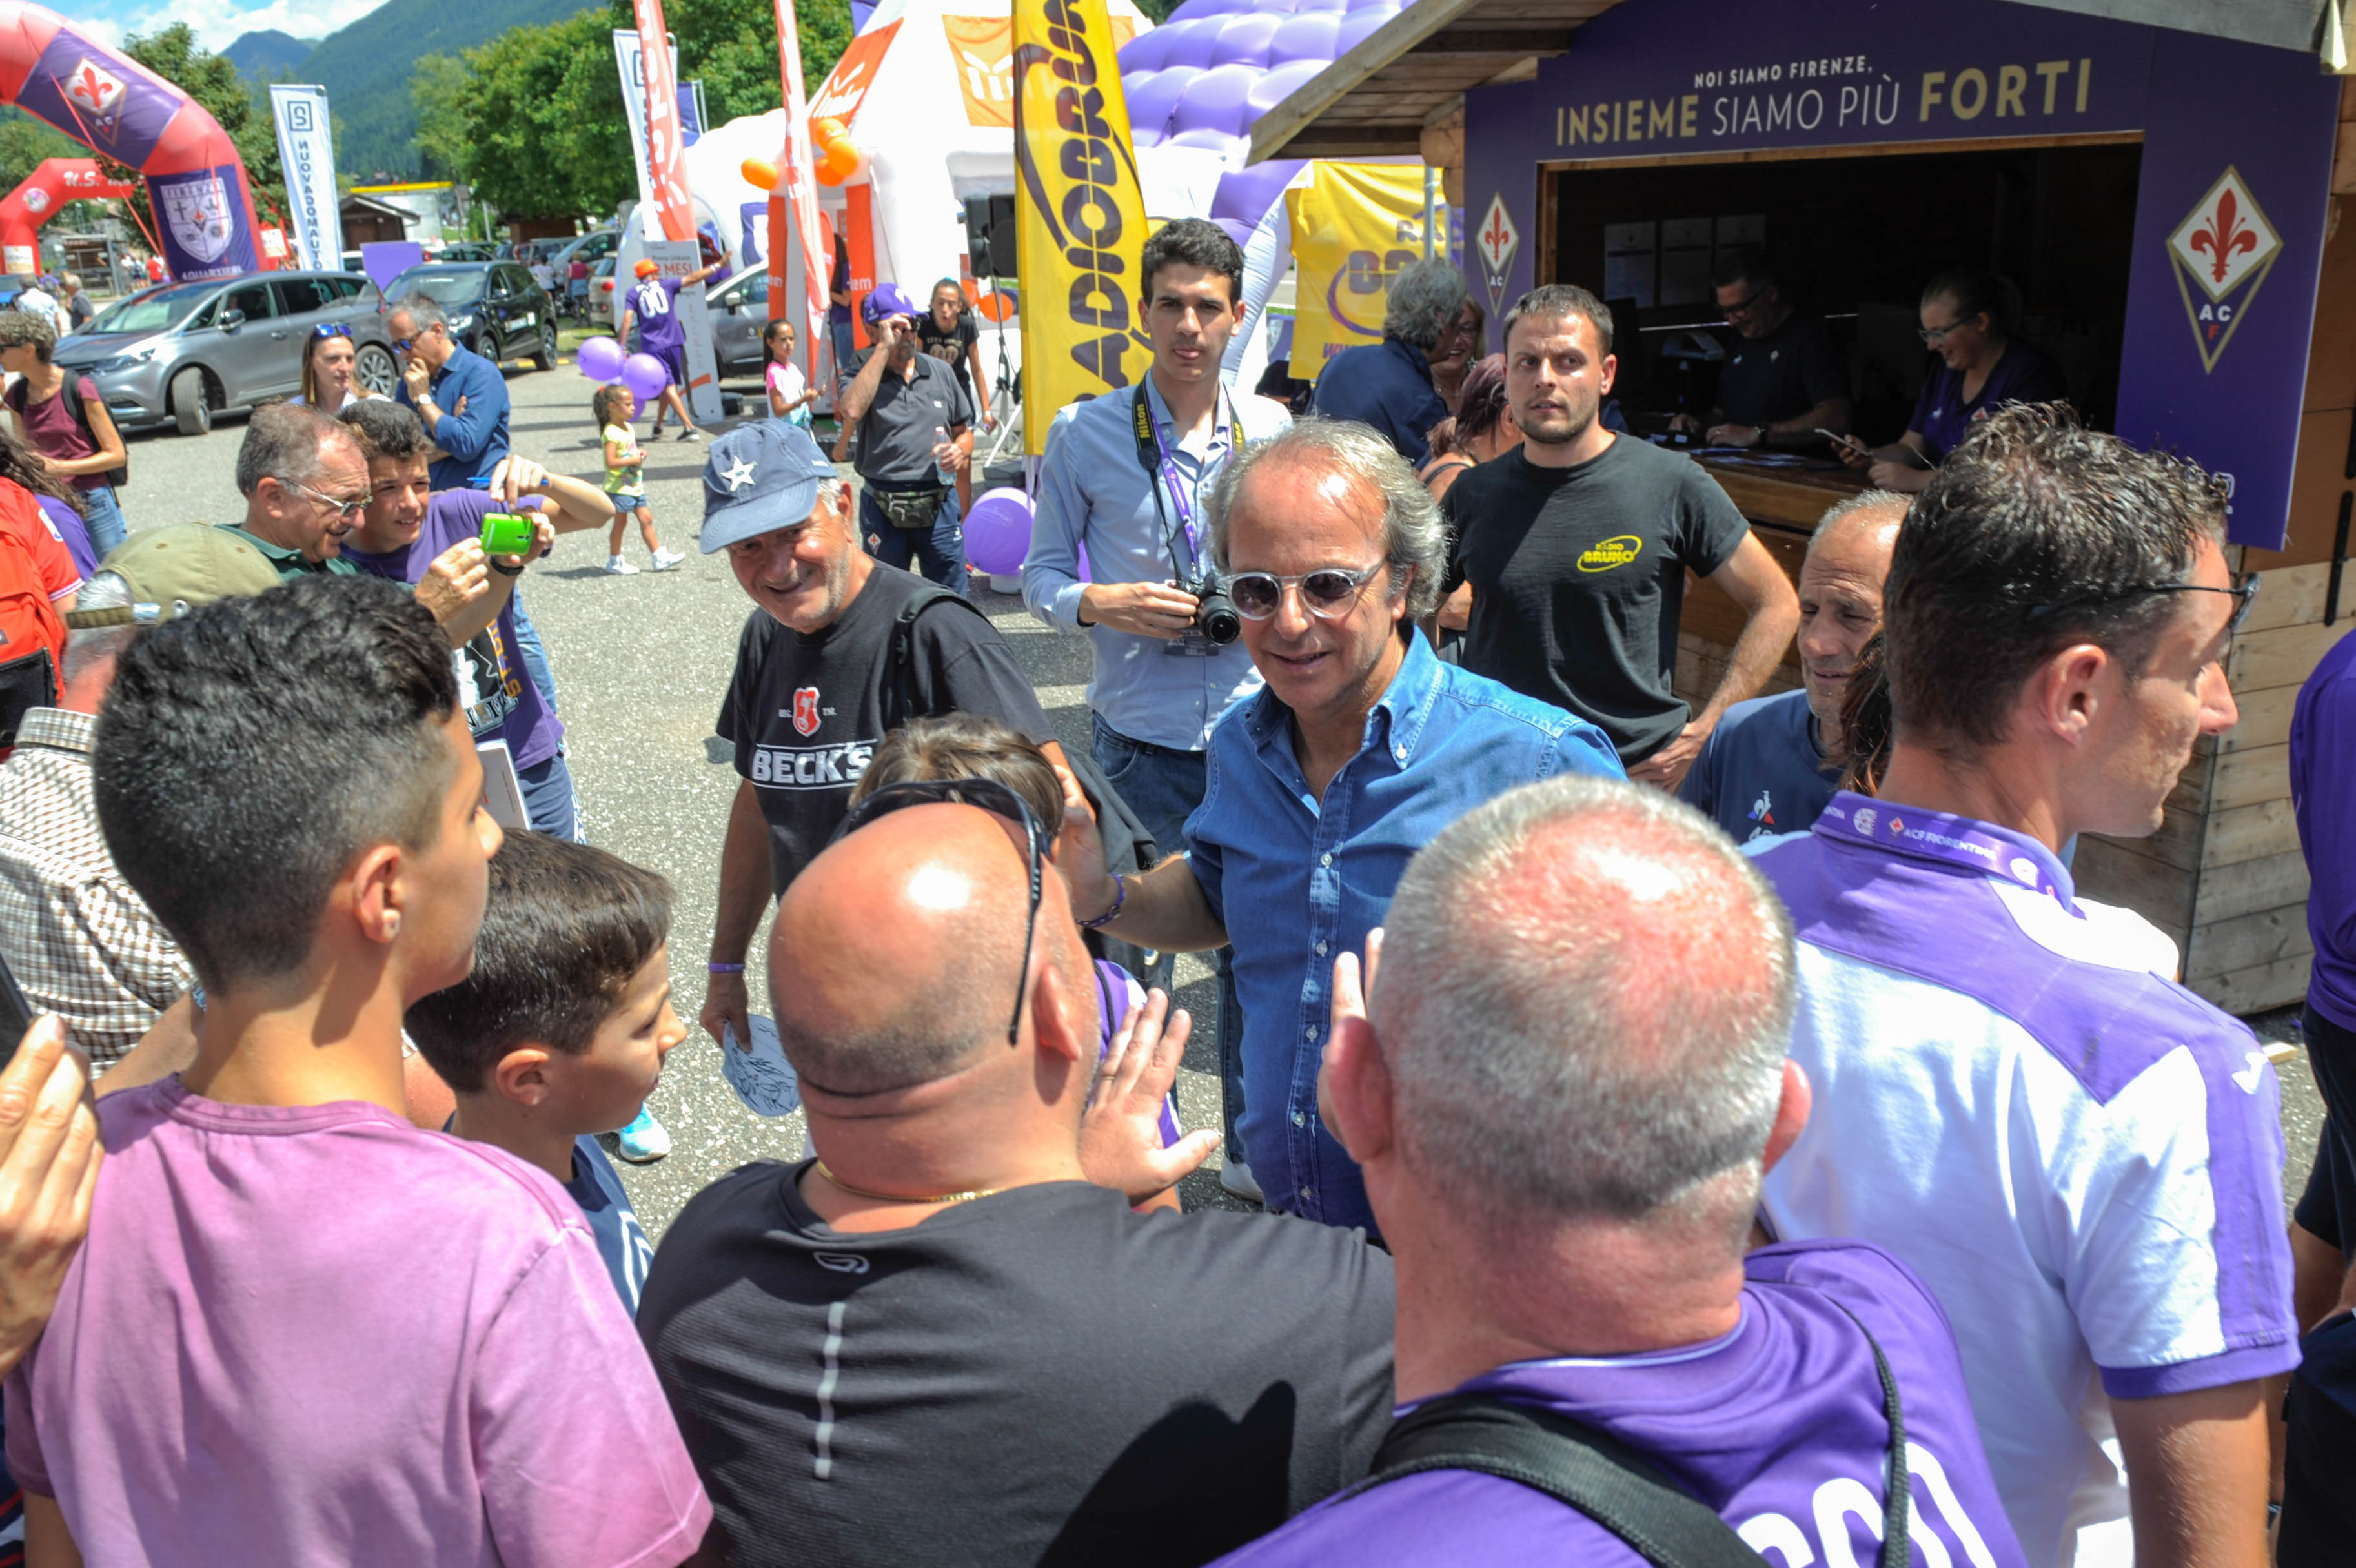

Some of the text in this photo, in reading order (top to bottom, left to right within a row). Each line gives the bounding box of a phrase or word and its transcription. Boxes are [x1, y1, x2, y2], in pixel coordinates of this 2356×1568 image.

[1694, 55, 1873, 88] NOI SIAMO FIRENZE,
[1556, 57, 2091, 146] INSIEME SIAMO PIÙ FORTI
[665, 263, 693, 276] MESI
[1490, 276, 1503, 287] AC
[2199, 304, 2231, 322] AC
[2208, 325, 2219, 339] F
[1137, 403, 1151, 438] Nikon
[1583, 550, 1635, 563] BRUNO
[751, 742, 873, 784] BECK'S
